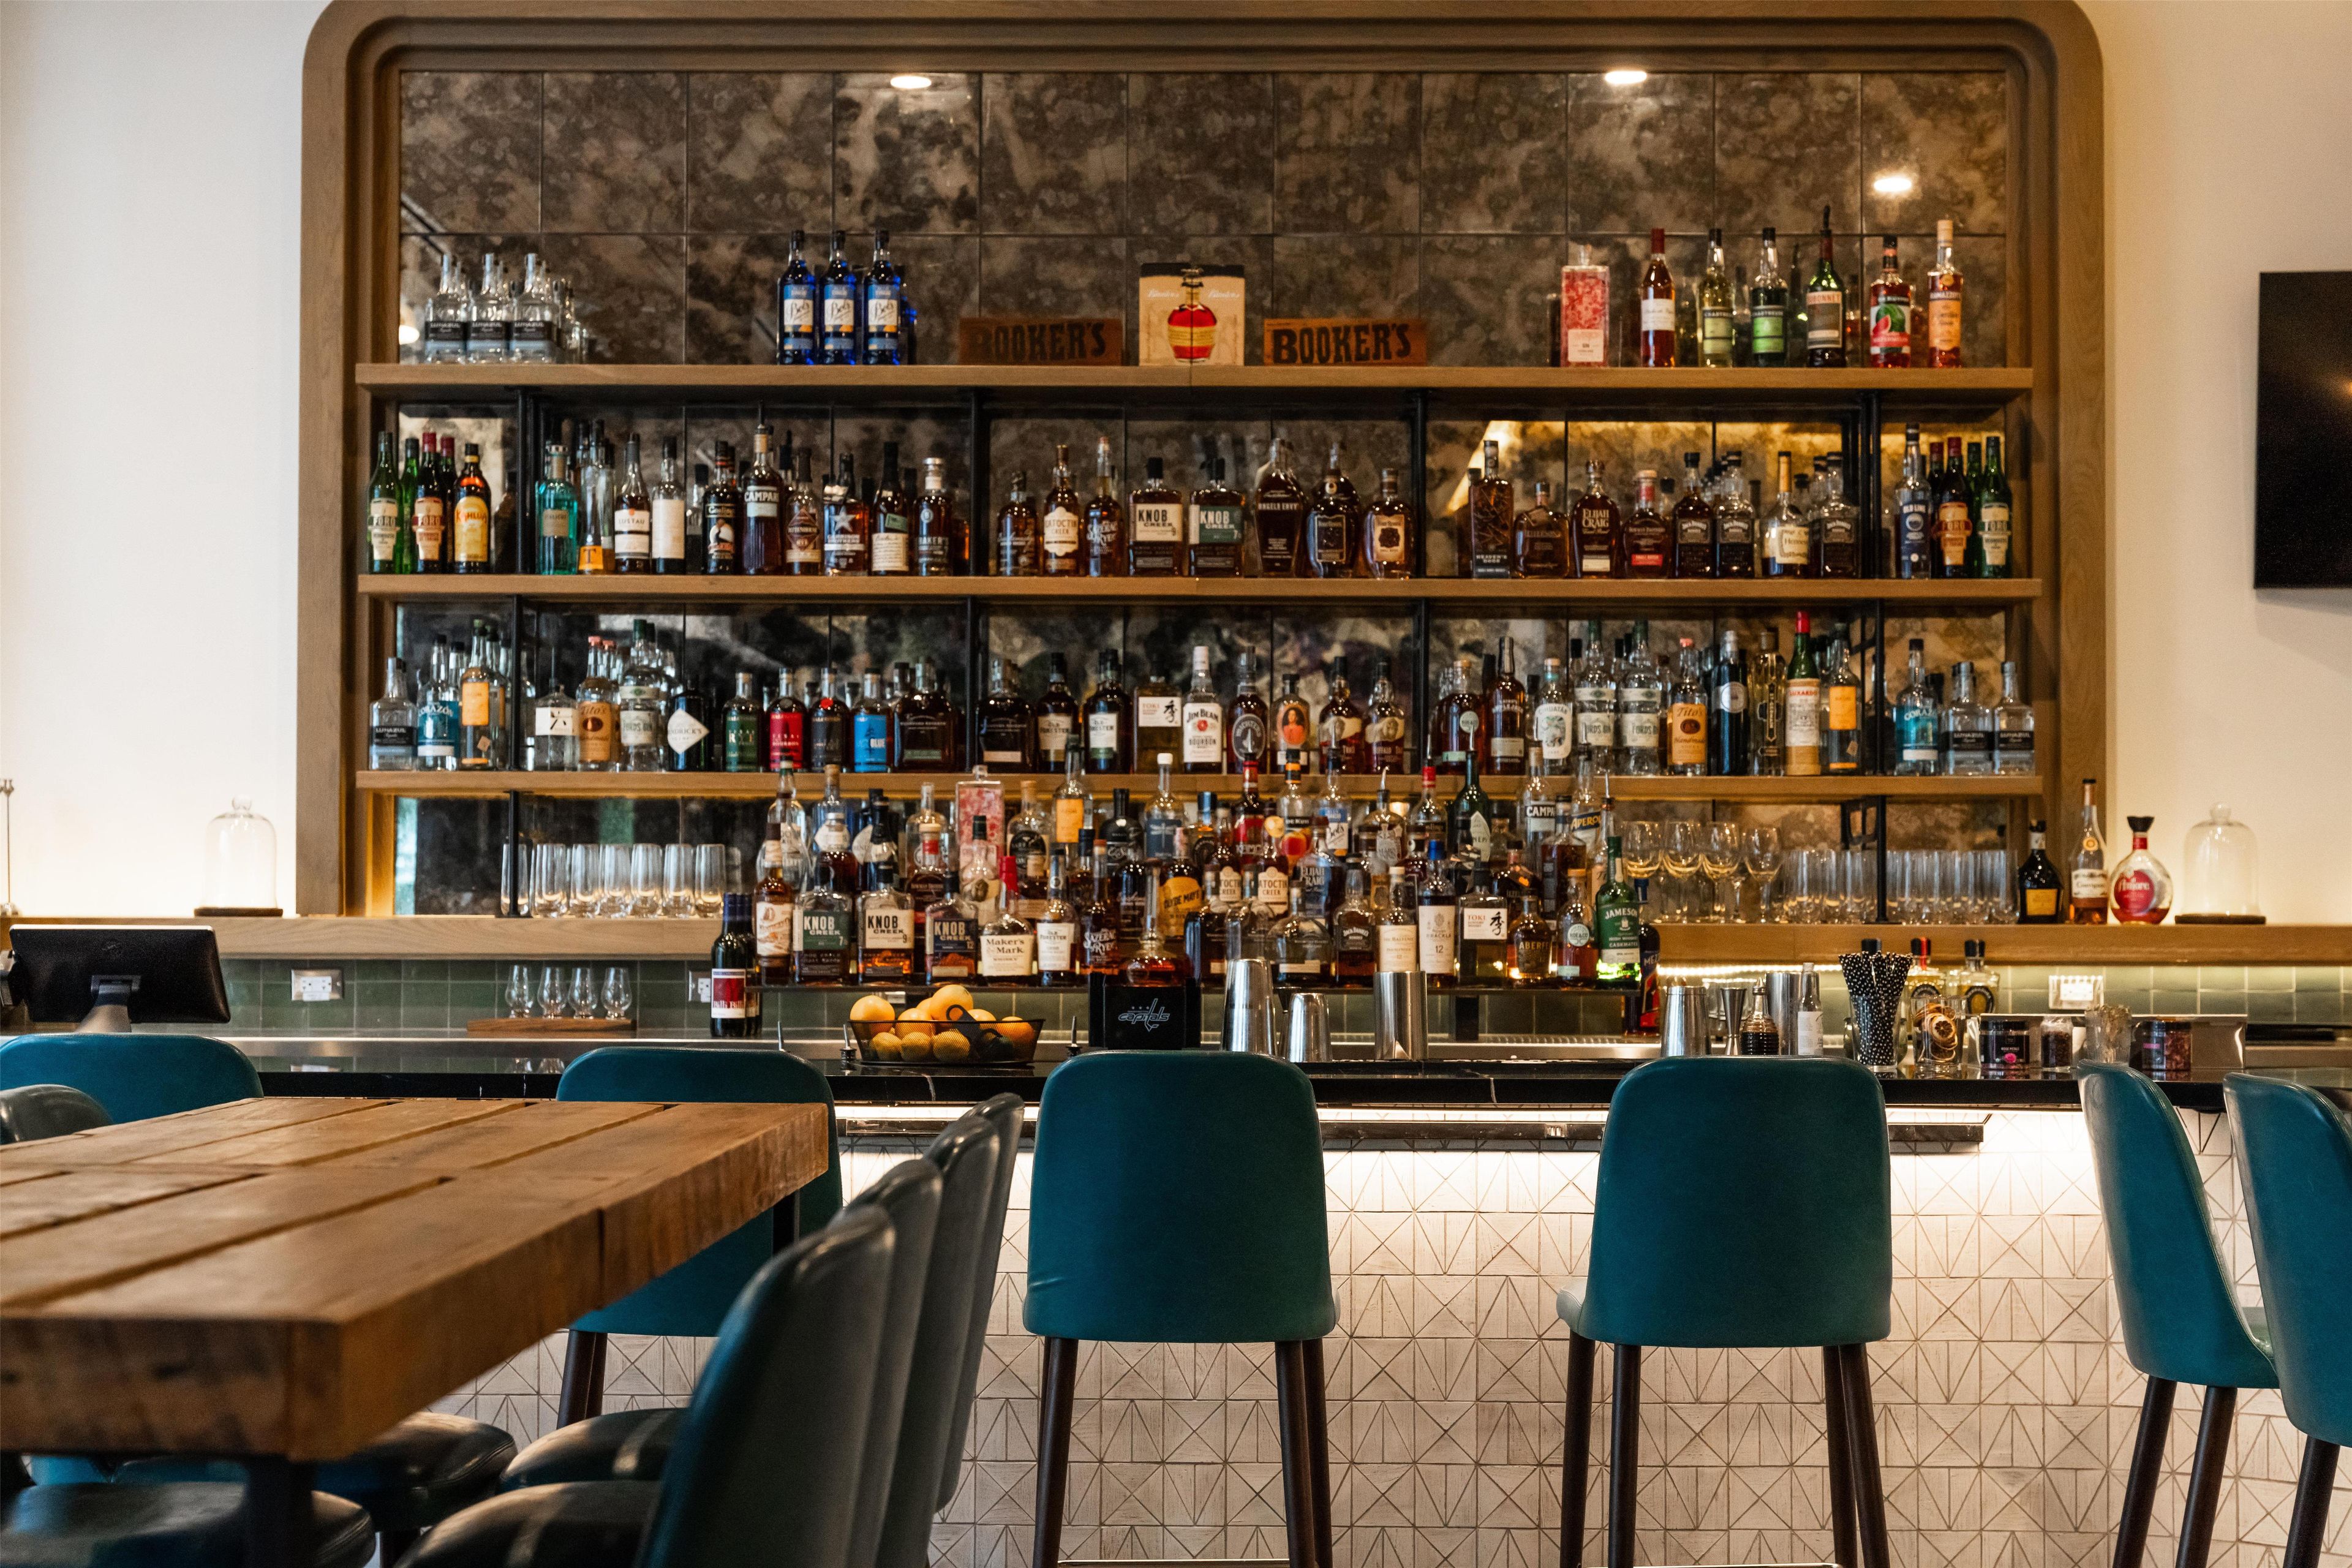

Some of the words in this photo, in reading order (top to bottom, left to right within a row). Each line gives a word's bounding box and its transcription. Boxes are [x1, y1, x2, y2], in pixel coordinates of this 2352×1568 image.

[1273, 323, 1411, 364] BOOKER'S
[1138, 510, 1168, 522] KNOB
[1200, 511, 1230, 524] KNOB
[1582, 509, 1610, 518] ELIJAH
[1582, 518, 1610, 529] CRAIG
[581, 704, 606, 715] Tito's
[1677, 706, 1704, 716] Tito's
[1186, 710, 1199, 723] JIM
[1199, 709, 1219, 723] BEAM
[1631, 726, 1652, 735] FORDS
[1526, 805, 1555, 817] CAMPA
[1605, 908, 1638, 919] JAMESON
[804, 916, 835, 930] KNOB
[867, 916, 899, 929] KNOB
[934, 921, 966, 936] KNOB
[1490, 911, 1505, 936] 季
[902, 933, 908, 944] 9
[1436, 945, 1444, 954] 12
[1118, 998, 1170, 1032] capitals
